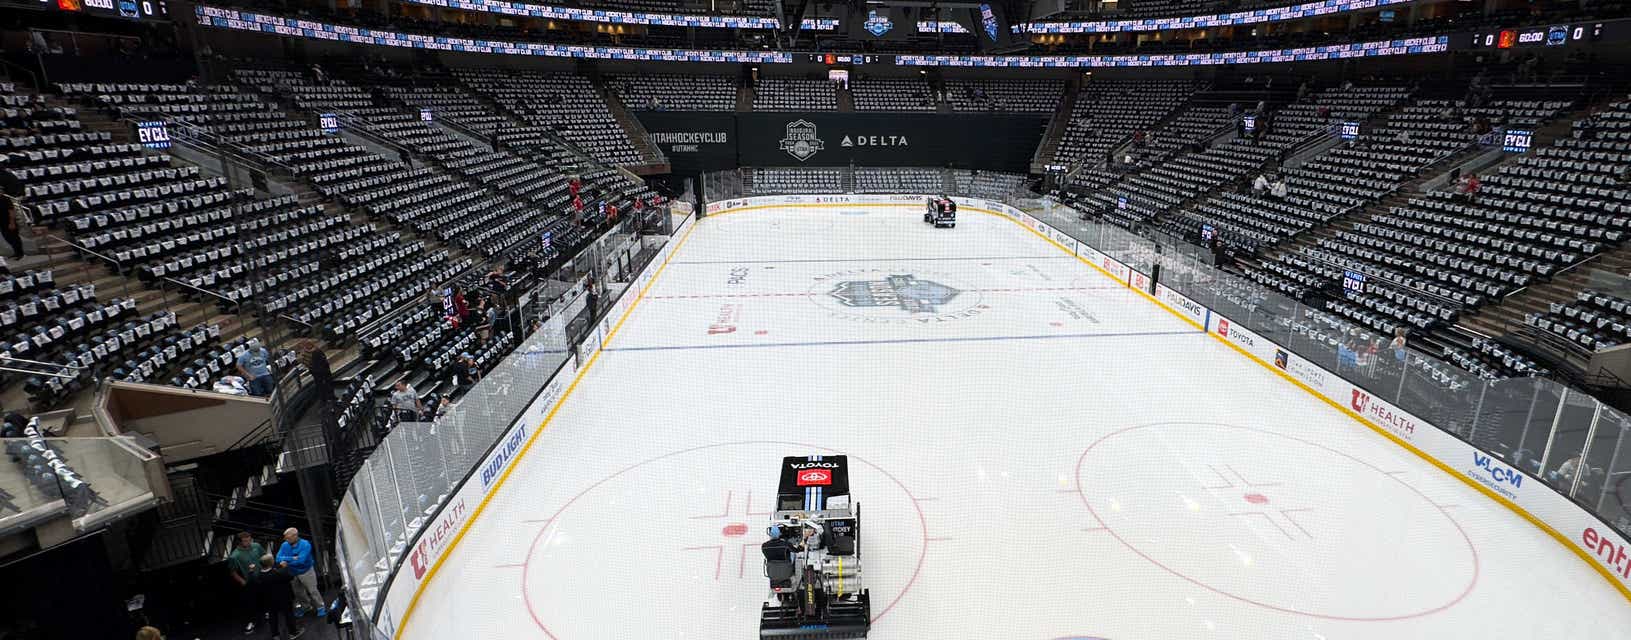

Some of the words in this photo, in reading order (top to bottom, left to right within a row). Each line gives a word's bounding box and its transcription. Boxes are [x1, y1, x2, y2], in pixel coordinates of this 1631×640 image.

[1486, 35, 1493, 45] 0
[1518, 32, 1543, 43] 60:00
[1573, 27, 1583, 40] 0
[858, 135, 908, 146] DELTA
[1230, 328, 1254, 347] TOYOTA
[1369, 402, 1414, 434] HEALTH
[483, 450, 503, 486] BUD
[504, 424, 527, 458] LIGHT
[428, 499, 464, 550] HEALTH
